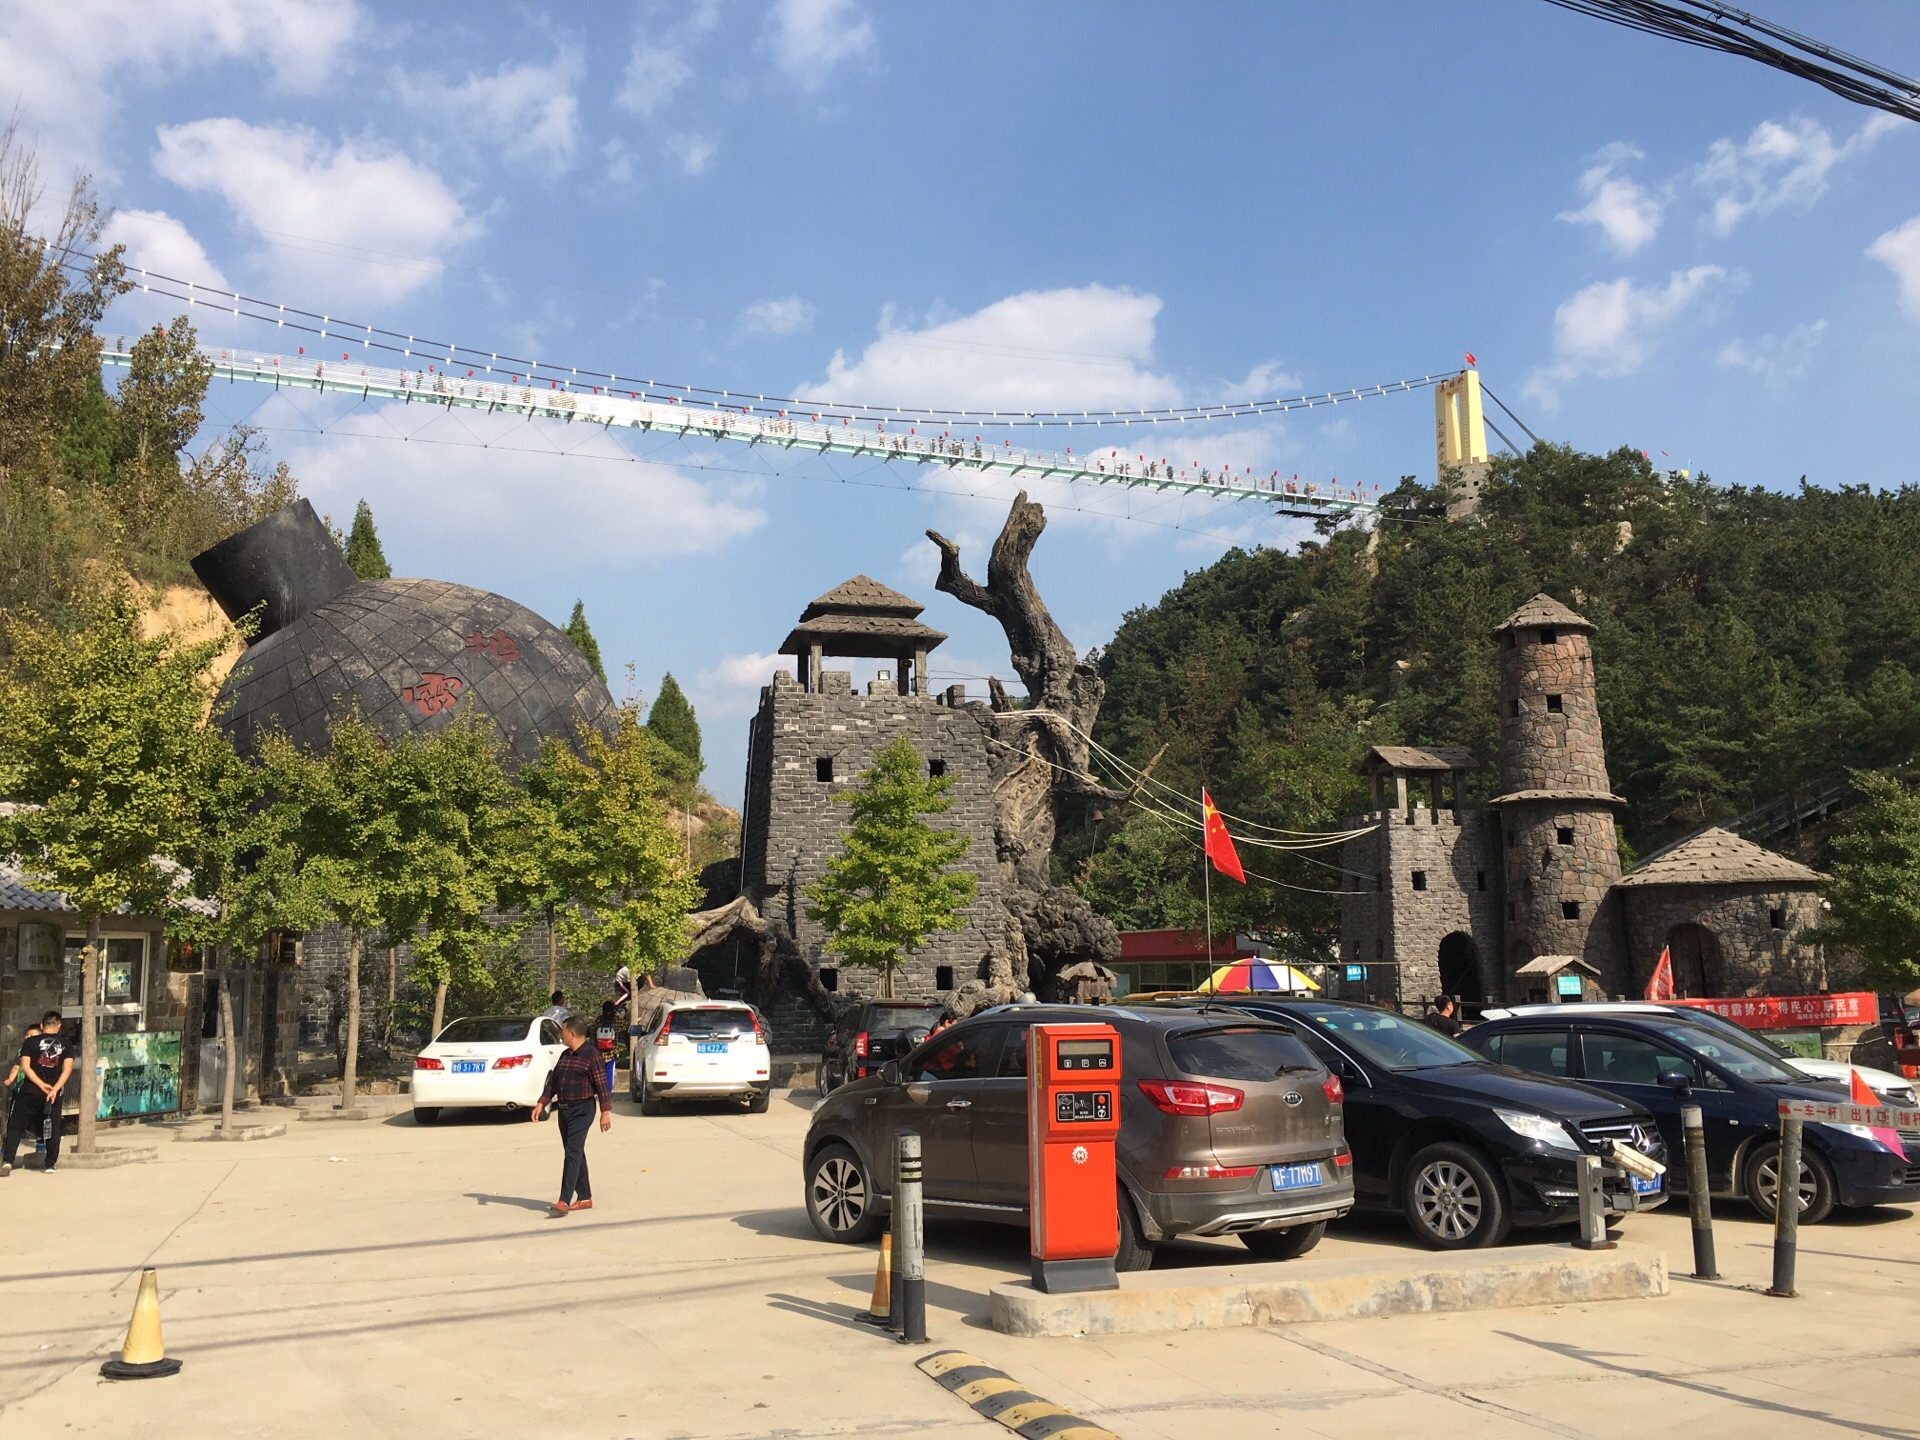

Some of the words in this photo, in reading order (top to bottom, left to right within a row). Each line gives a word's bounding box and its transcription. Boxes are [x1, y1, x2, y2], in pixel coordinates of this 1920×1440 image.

[1778, 1001, 1814, 1014] 得民心
[1823, 998, 1859, 1013] 顺民意
